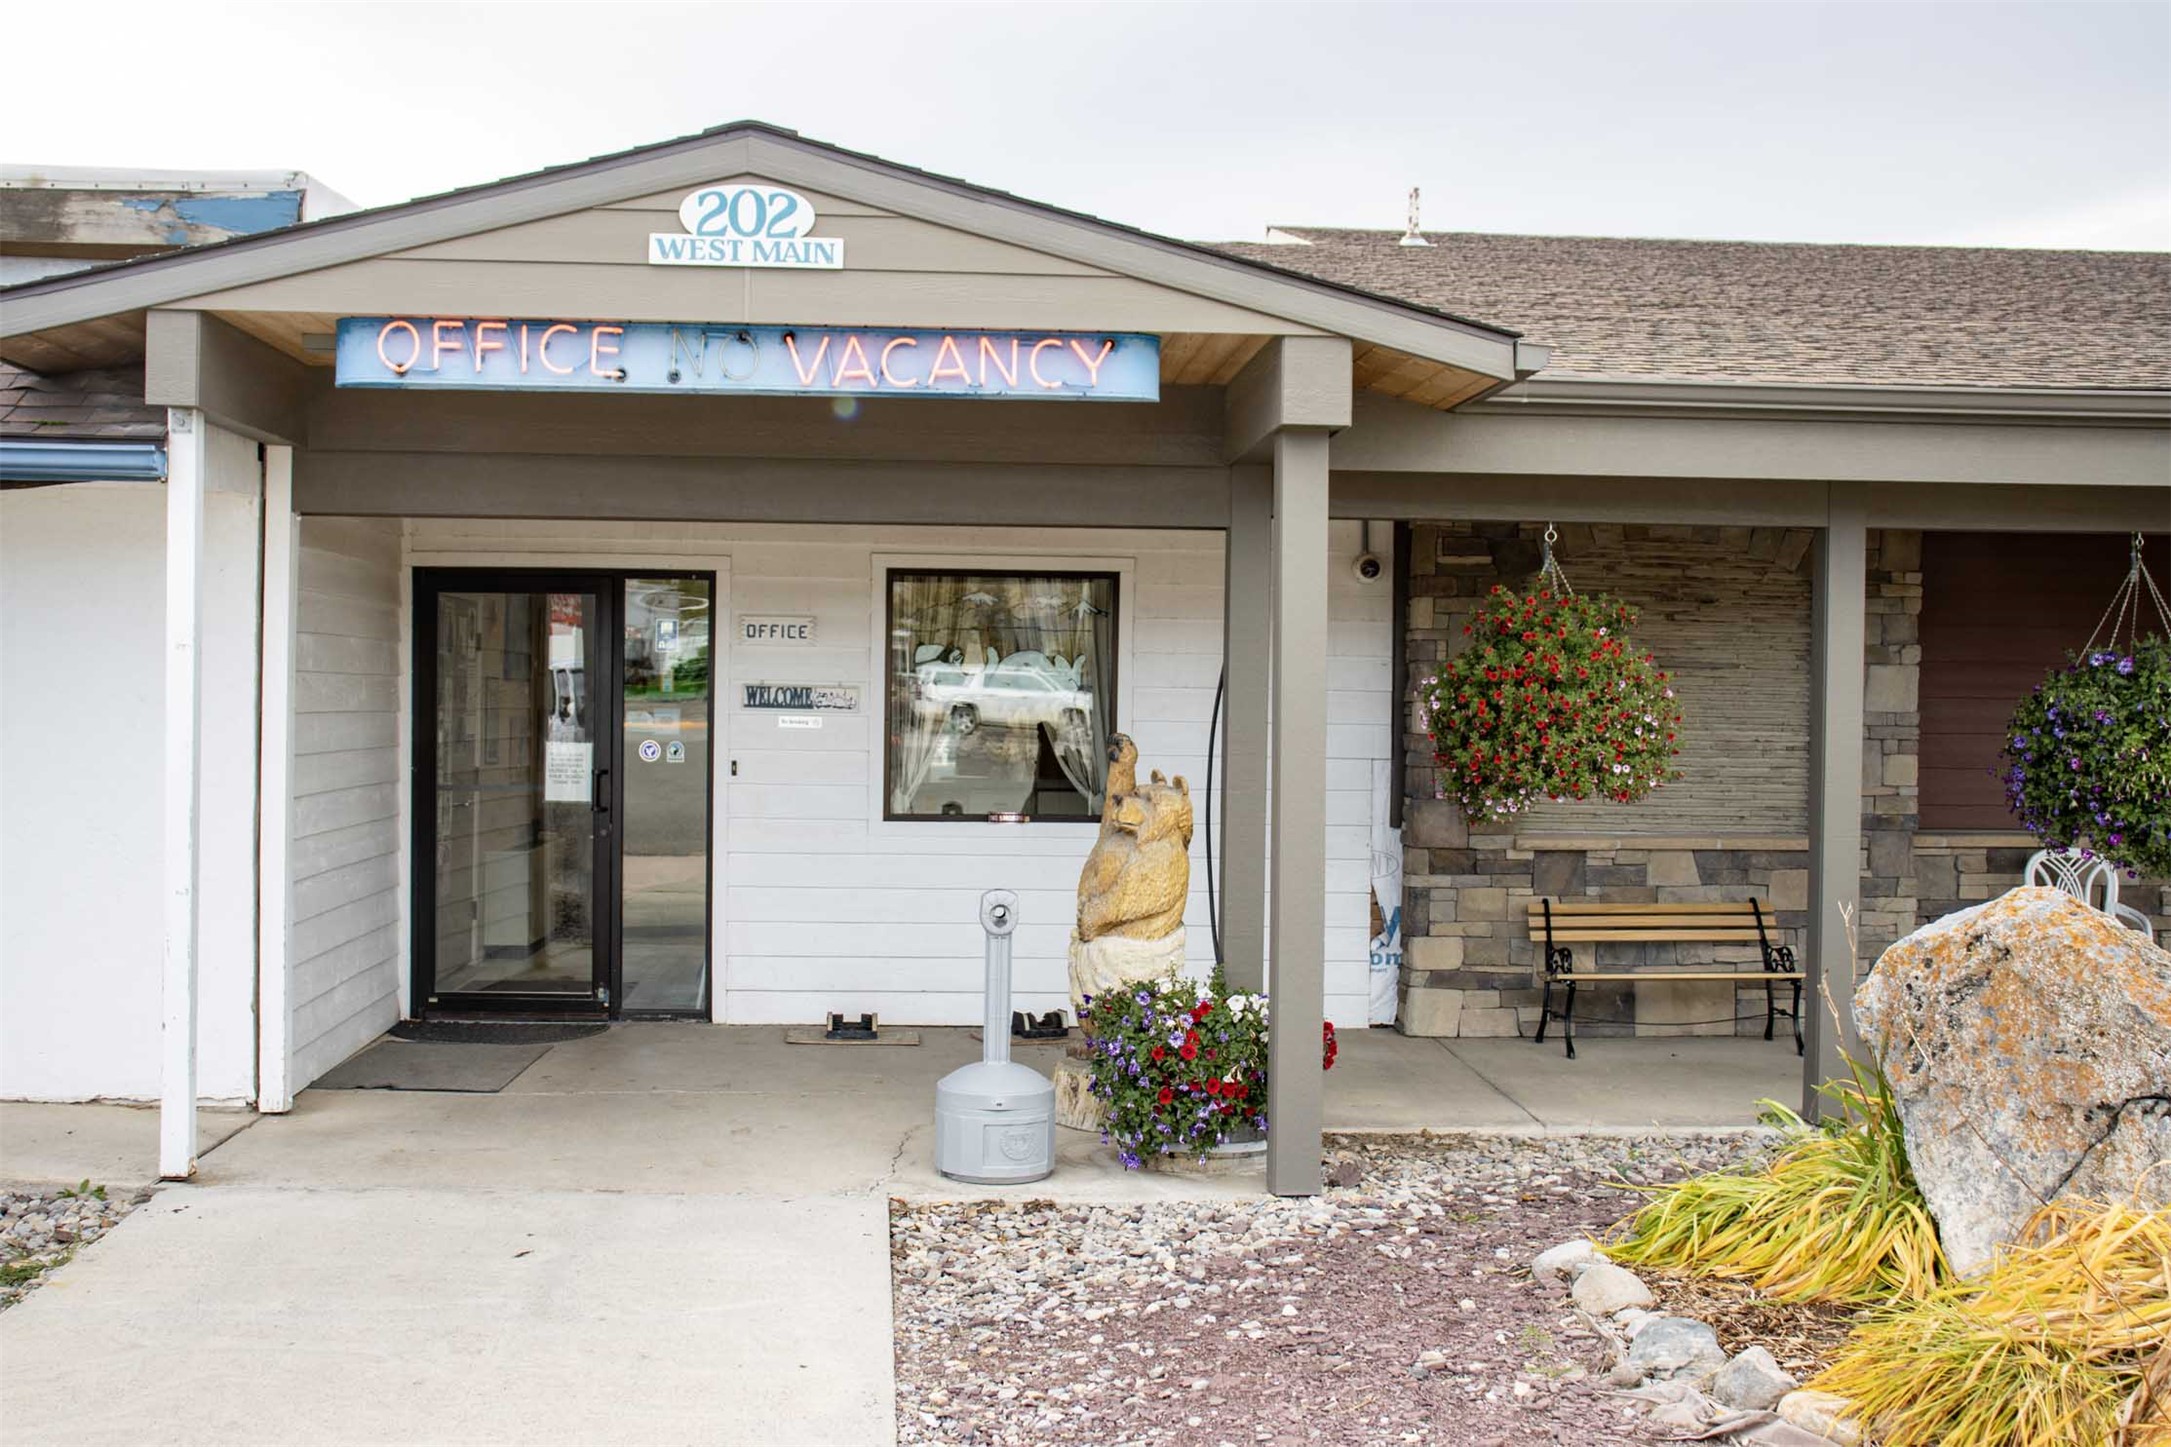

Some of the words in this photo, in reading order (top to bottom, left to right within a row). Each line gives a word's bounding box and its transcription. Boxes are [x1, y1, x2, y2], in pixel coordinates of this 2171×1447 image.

[696, 188, 798, 239] 202
[655, 238, 743, 262] WEST
[753, 239, 835, 265] MAIN
[377, 320, 624, 377] OFFICE
[670, 326, 760, 381] NO
[785, 334, 1115, 388] VACANCY
[746, 624, 808, 639] OFFICE
[745, 685, 813, 708] WELCOME
